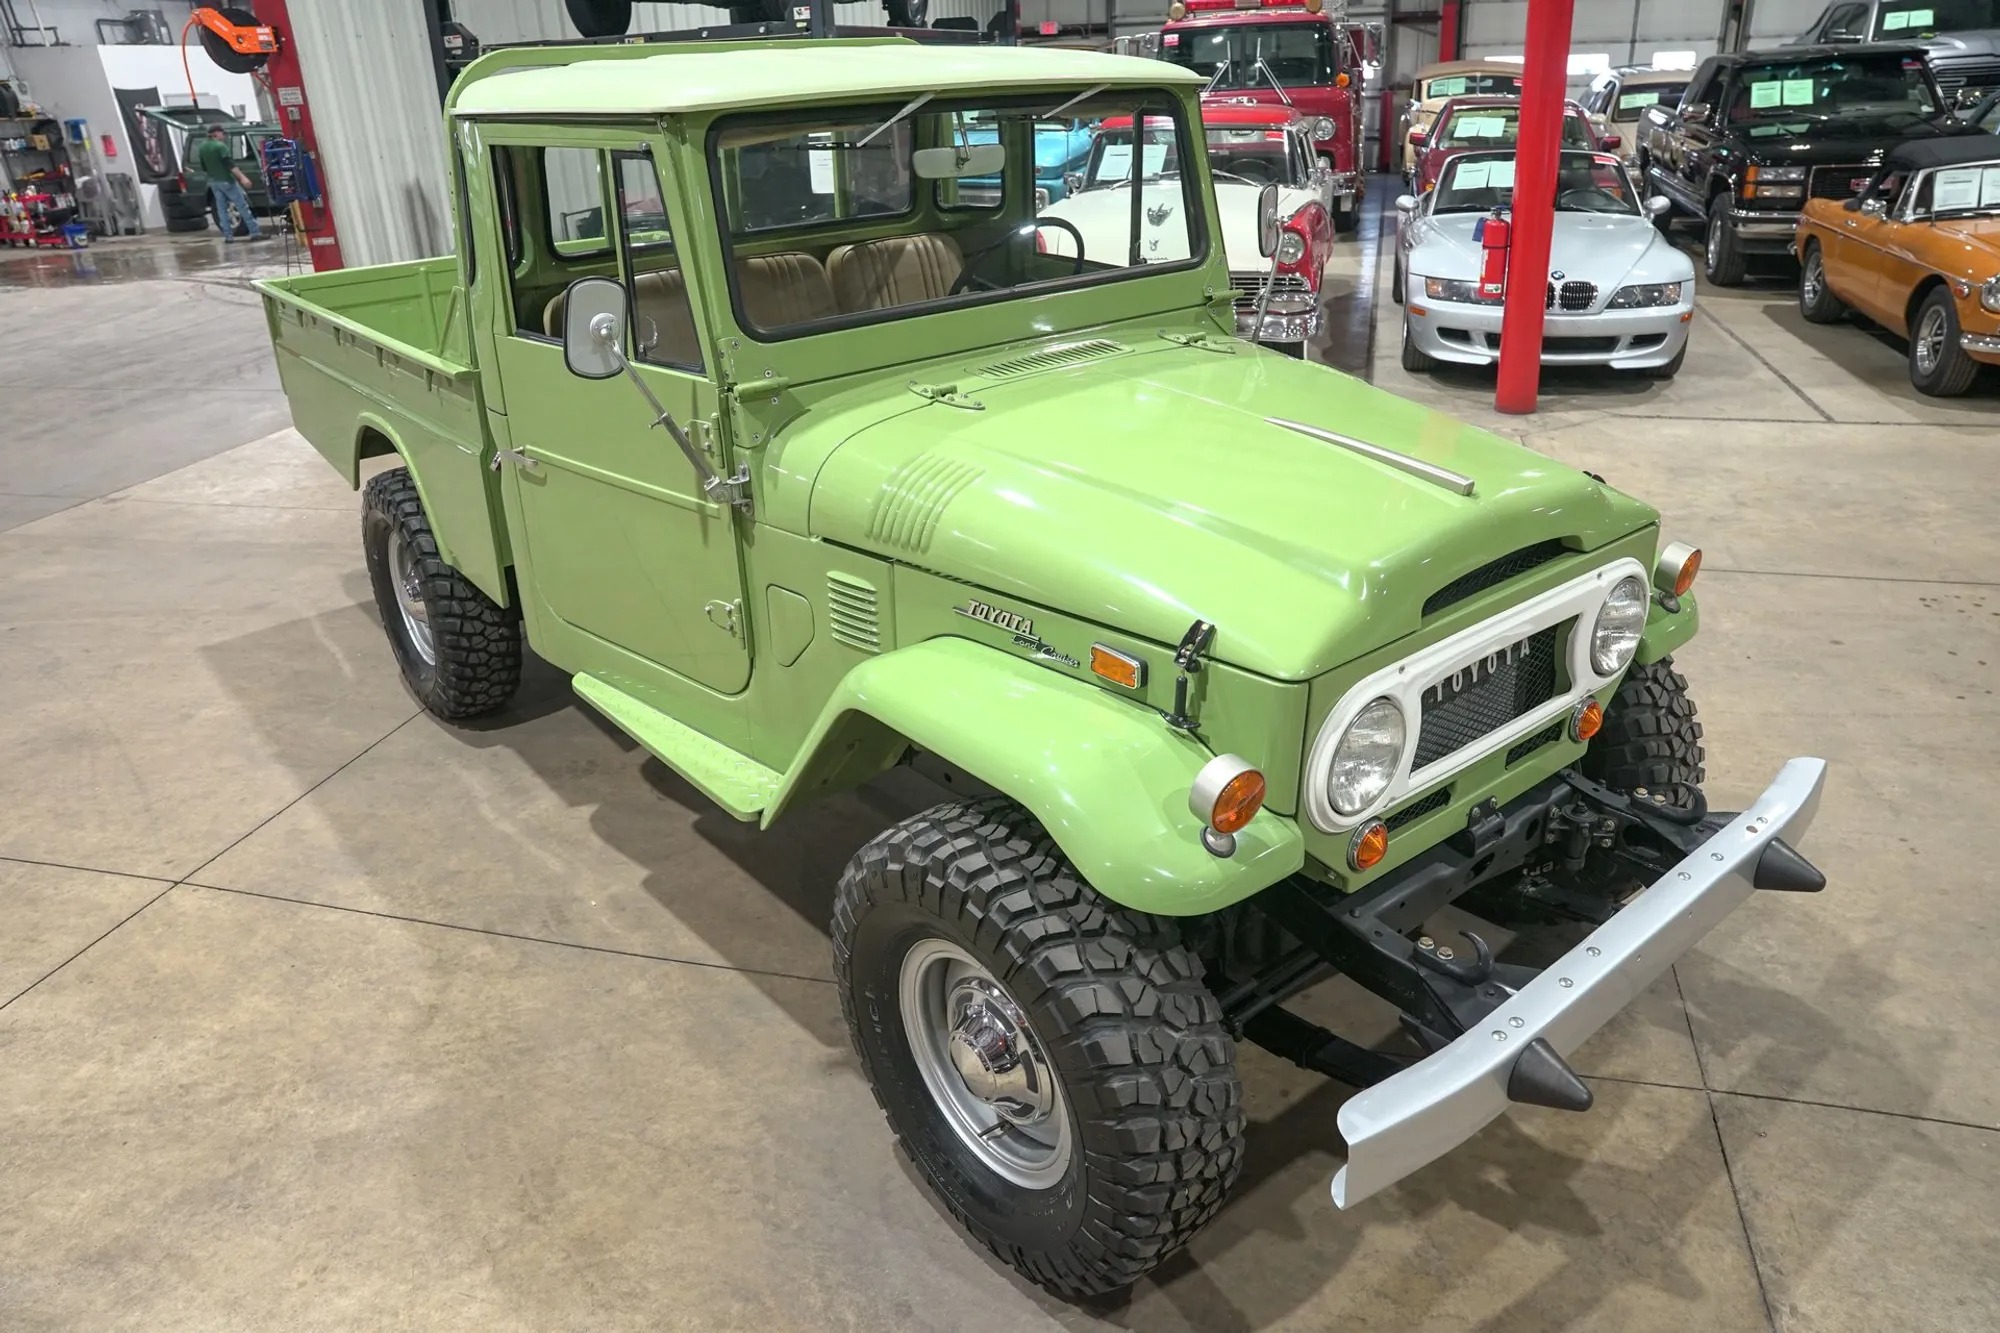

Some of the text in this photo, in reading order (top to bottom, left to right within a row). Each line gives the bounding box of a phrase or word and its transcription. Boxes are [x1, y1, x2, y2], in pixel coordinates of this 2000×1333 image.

[967, 599, 1033, 635] TOYOTA
[1010, 634, 1080, 668] Land Cruiser
[1434, 638, 1531, 703] TOYOTA
